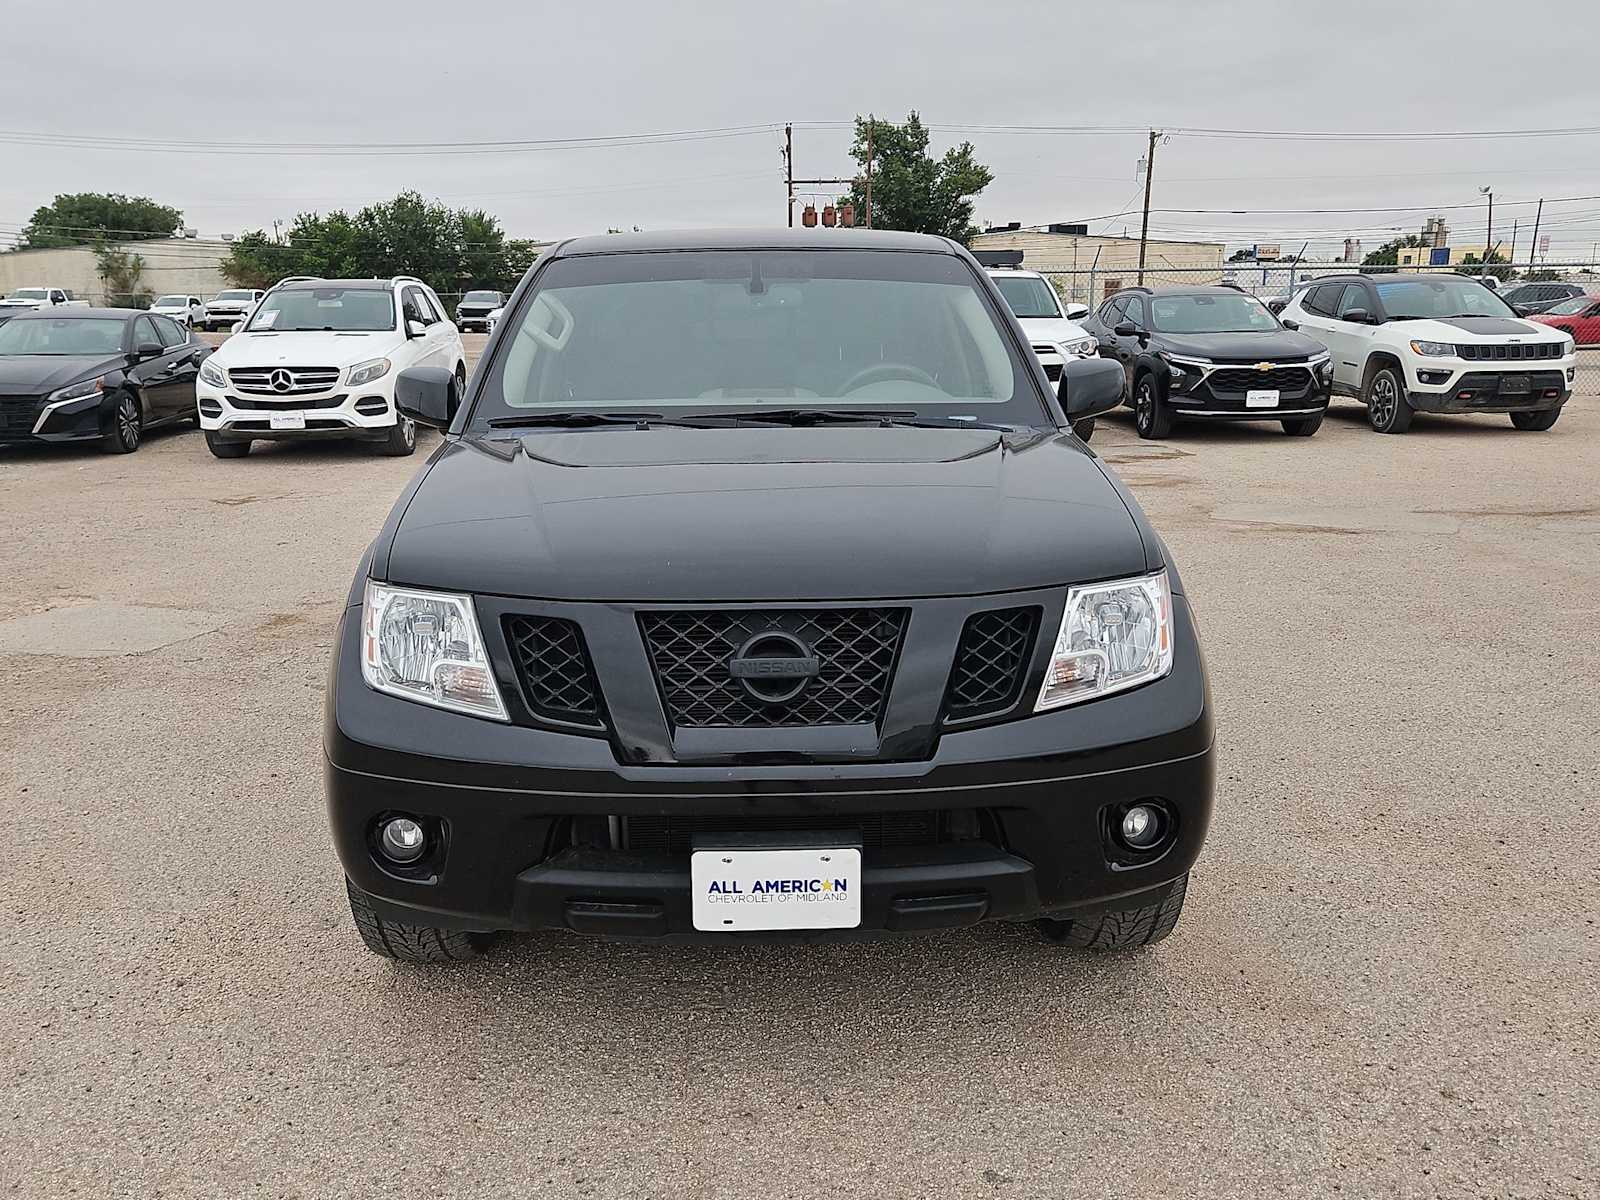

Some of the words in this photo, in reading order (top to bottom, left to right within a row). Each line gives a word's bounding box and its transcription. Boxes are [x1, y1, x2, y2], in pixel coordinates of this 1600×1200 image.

[737, 661, 811, 674] NISSAN
[708, 880, 743, 894] ALL
[751, 878, 847, 893] AMERICN
[707, 894, 774, 904] CHEVROLET
[777, 893, 793, 902] OF
[796, 892, 848, 902] MIDLAND
